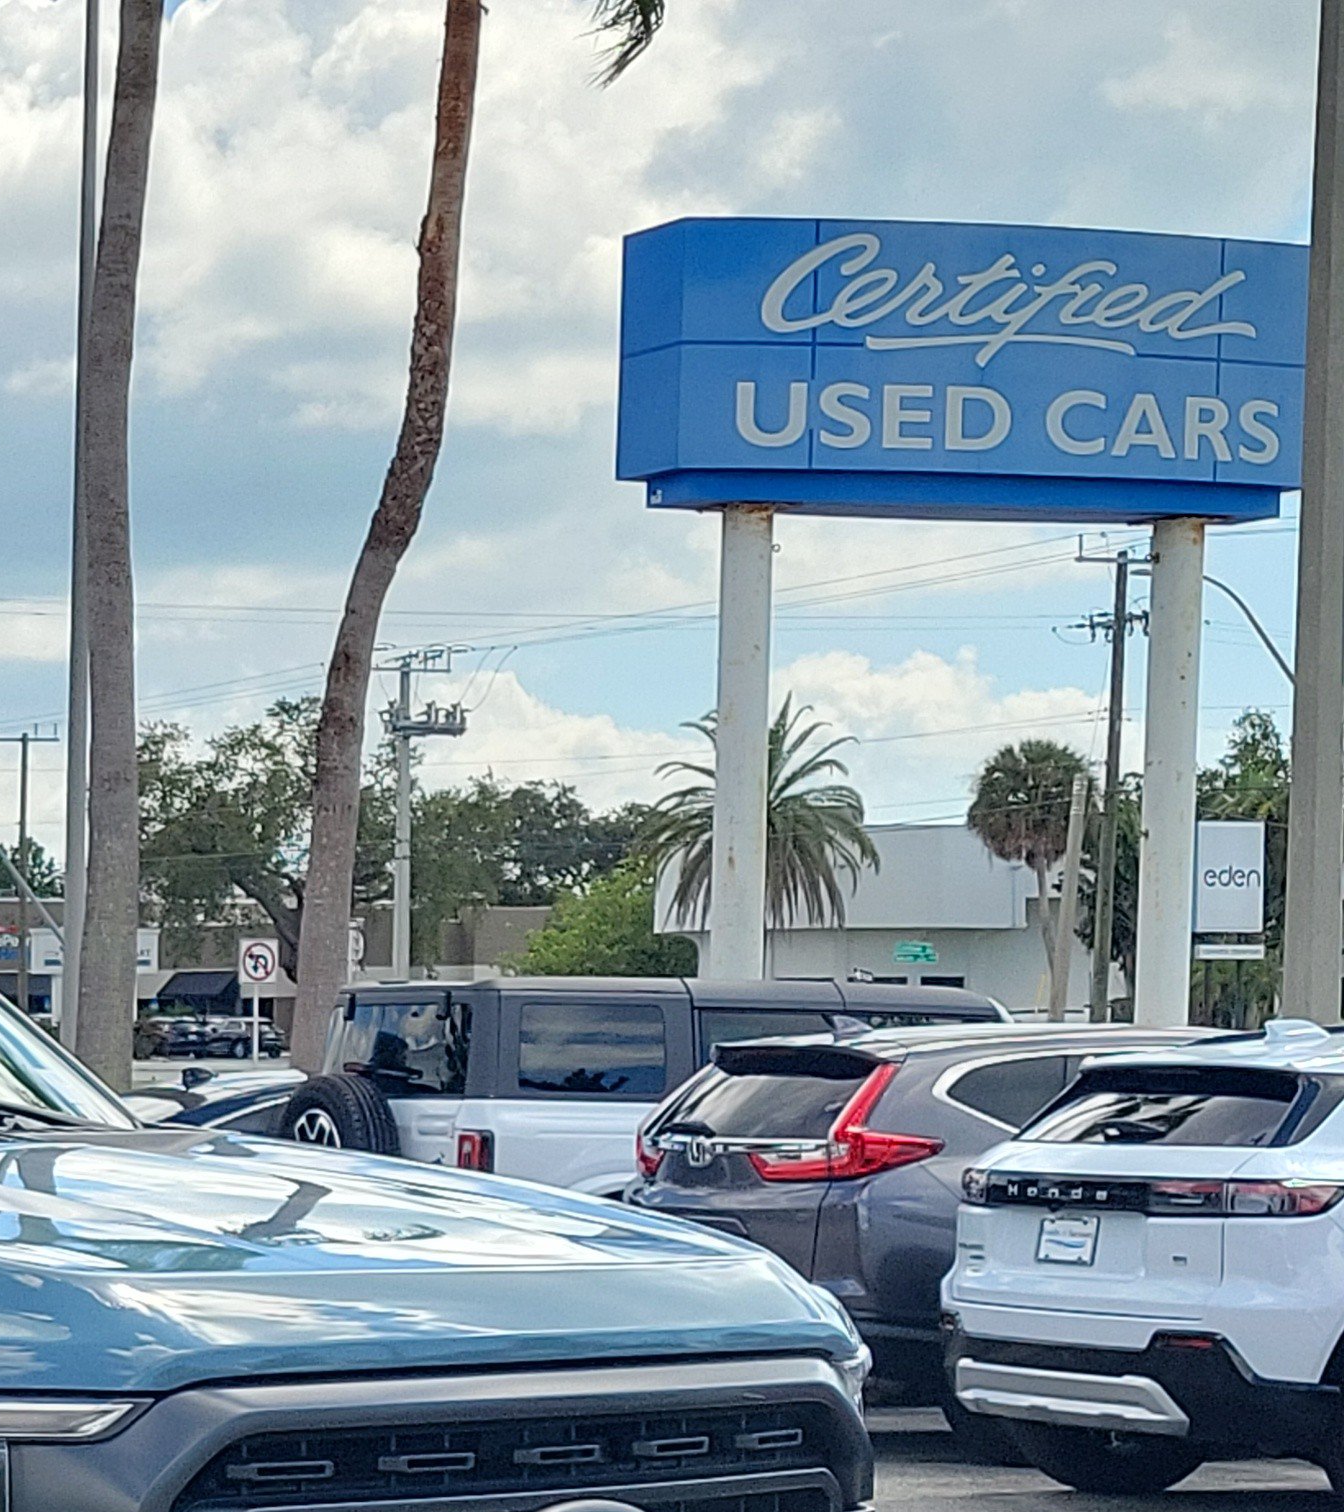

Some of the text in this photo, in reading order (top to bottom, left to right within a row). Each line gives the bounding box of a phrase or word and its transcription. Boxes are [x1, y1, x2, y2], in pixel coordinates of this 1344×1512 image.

[762, 234, 1257, 367] Certified
[735, 380, 1279, 463] USED CARS
[1204, 865, 1261, 887] eden
